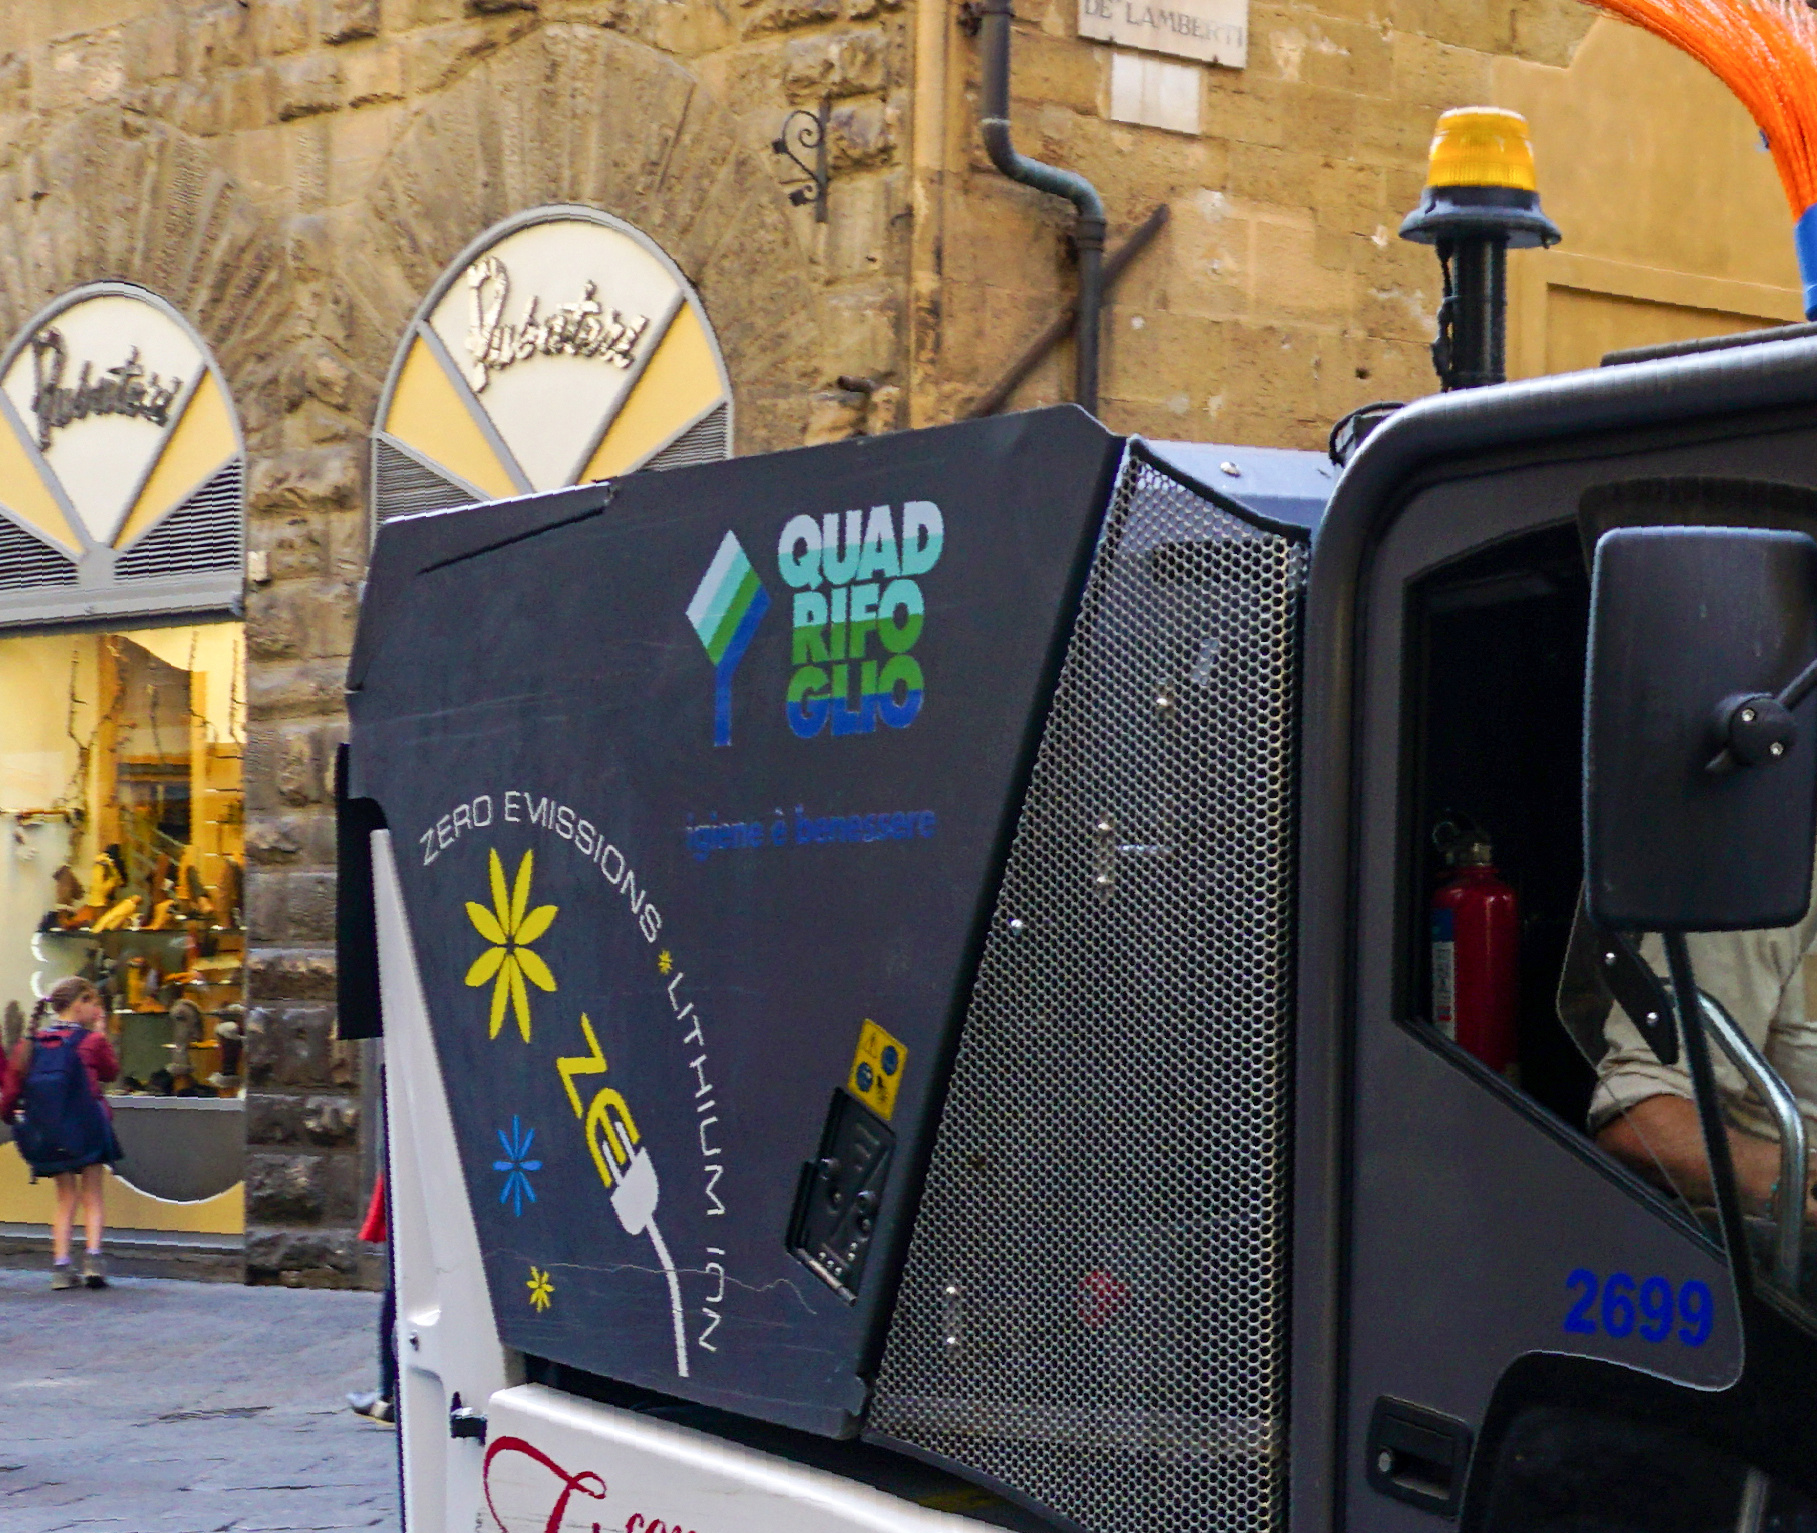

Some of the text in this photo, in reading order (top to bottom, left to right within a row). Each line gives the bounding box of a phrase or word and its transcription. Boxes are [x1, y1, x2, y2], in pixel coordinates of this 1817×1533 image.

[1126, 1, 1244, 48] LAMBERTI
[777, 500, 945, 589] QUAD
[792, 579, 925, 665] RIFO
[787, 655, 925, 738] GLIO
[686, 804, 937, 861] igiene è benessere
[419, 791, 726, 1353] ZERO EMISSIONS LITHIUM ION
[1563, 1268, 1714, 1348] 2699
